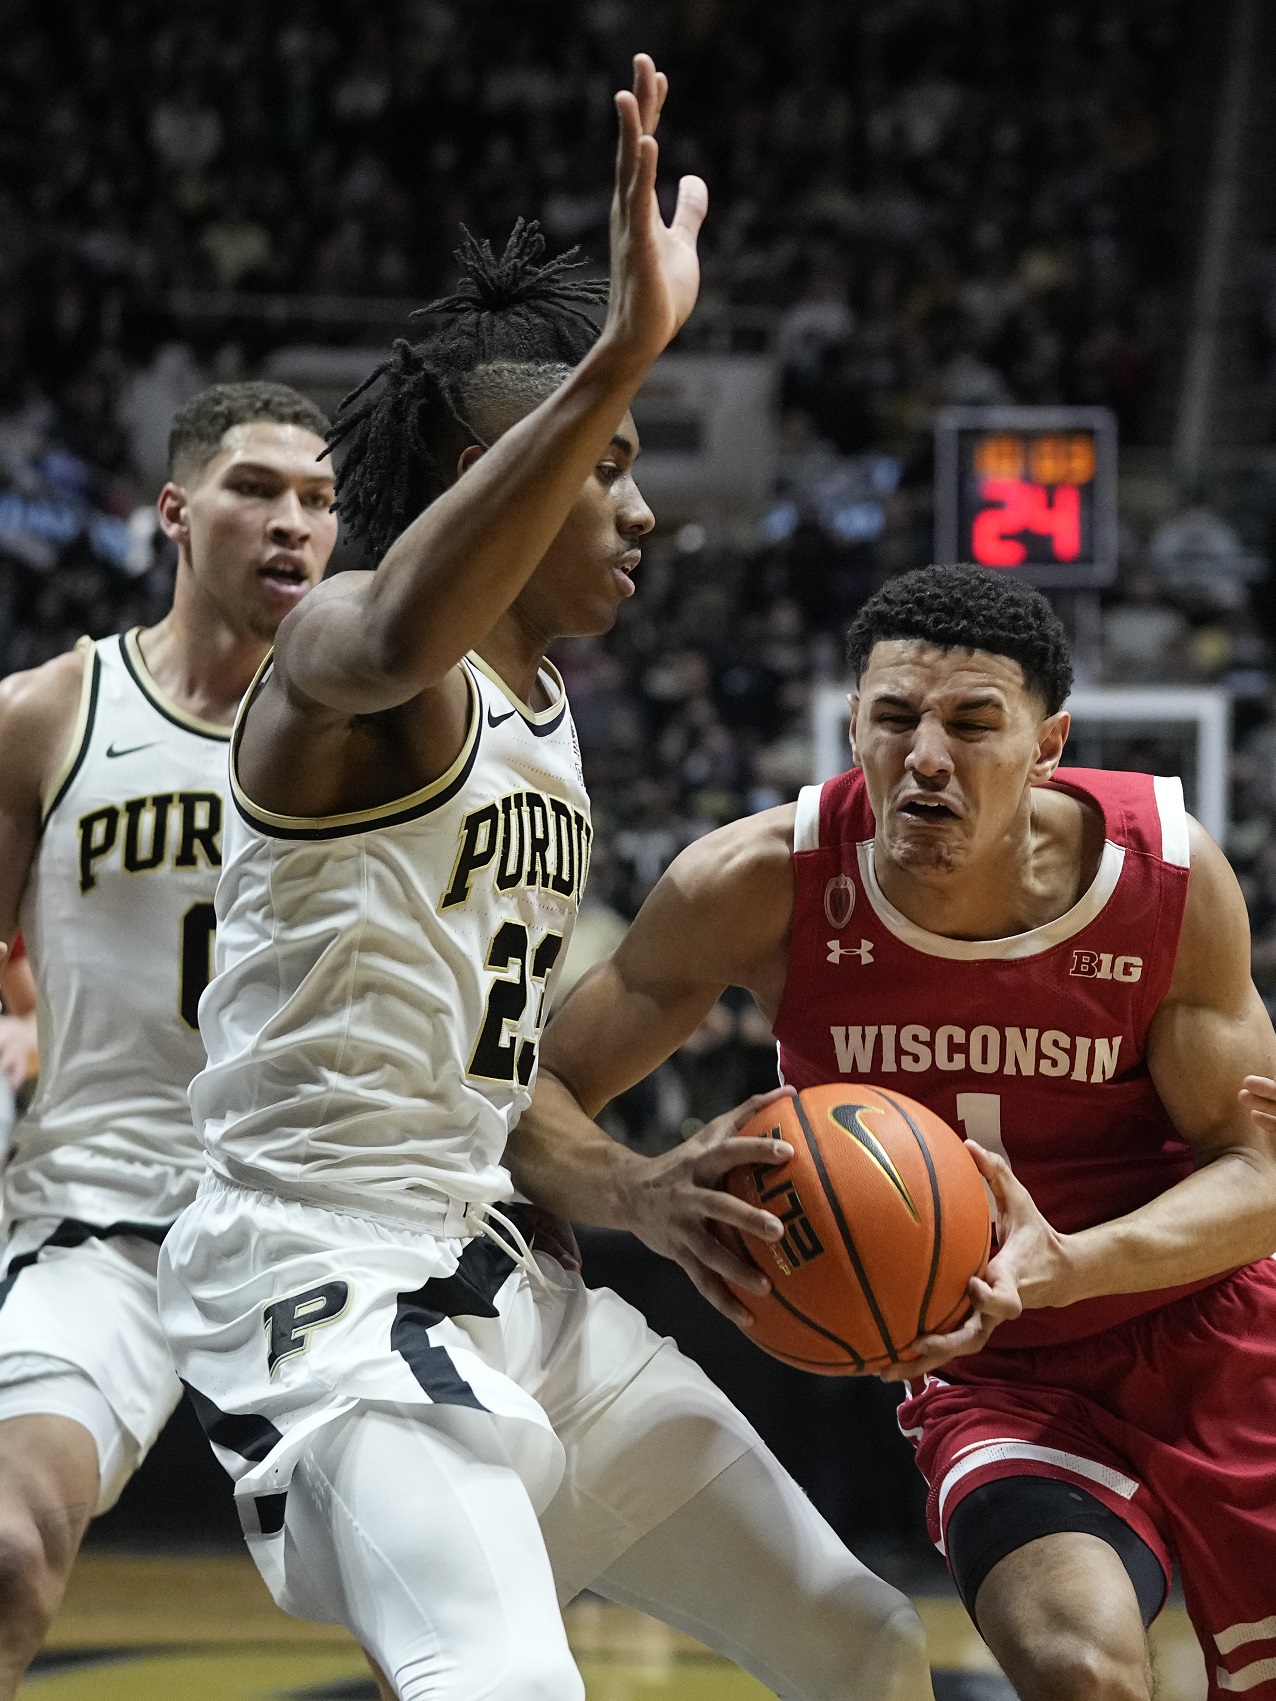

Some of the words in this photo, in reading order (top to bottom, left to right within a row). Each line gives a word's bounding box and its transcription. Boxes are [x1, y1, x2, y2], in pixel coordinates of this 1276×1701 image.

[972, 478, 1081, 567] 24
[79, 792, 224, 895] PUR
[436, 789, 594, 914] PURDU
[459, 917, 563, 1091] 23
[830, 1024, 1123, 1083] WISCONSIN
[956, 1093, 1012, 1222] 1
[261, 1276, 355, 1384] P
